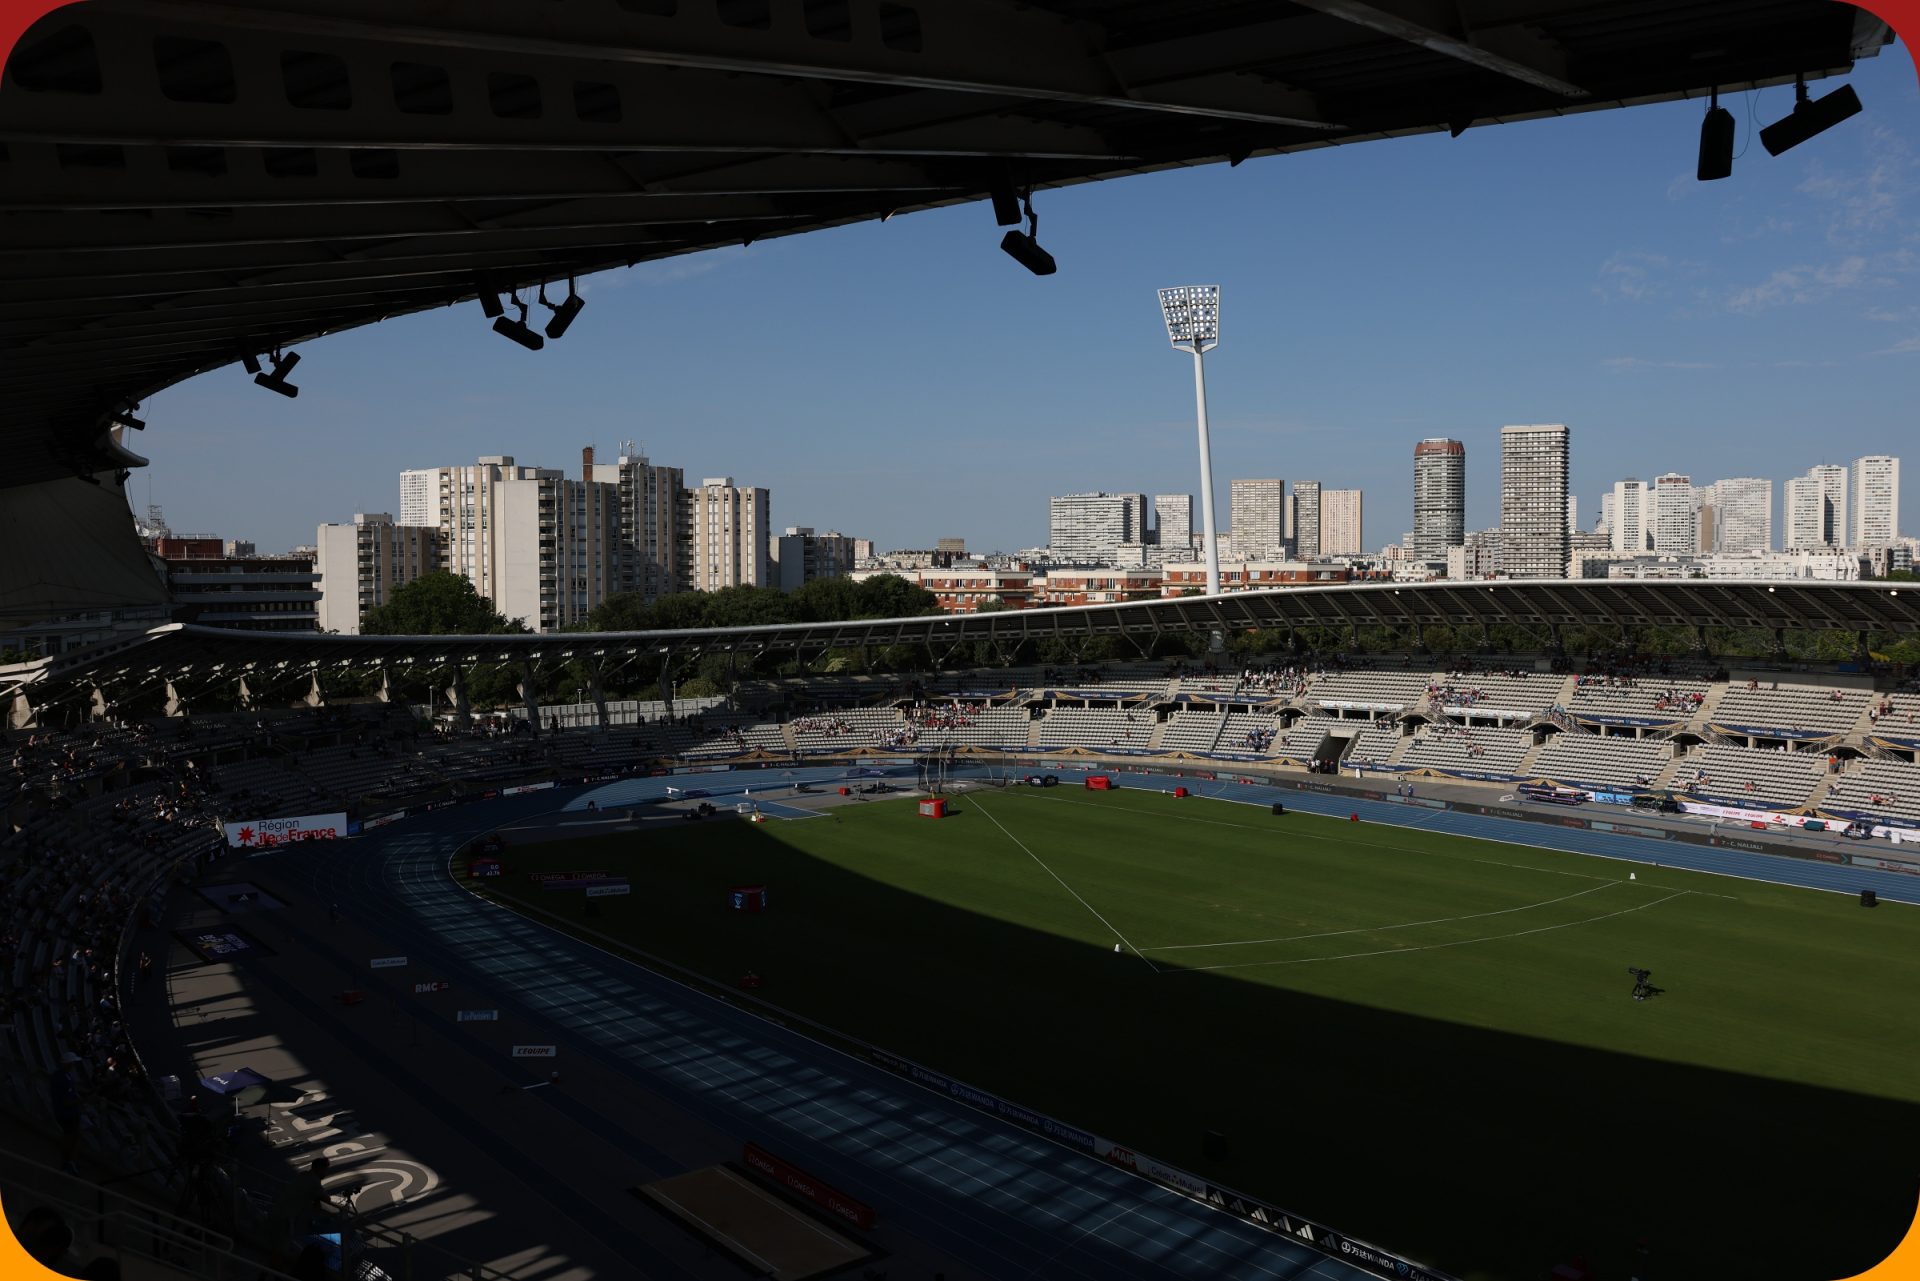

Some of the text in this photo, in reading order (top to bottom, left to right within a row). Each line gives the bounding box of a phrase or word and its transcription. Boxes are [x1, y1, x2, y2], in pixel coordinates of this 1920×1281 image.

[258, 820, 299, 833] Région
[415, 982, 438, 993] RMC
[1111, 1148, 1136, 1166] MAIF
[793, 1180, 815, 1198] OMEGA
[836, 1203, 859, 1222] OMEGA
